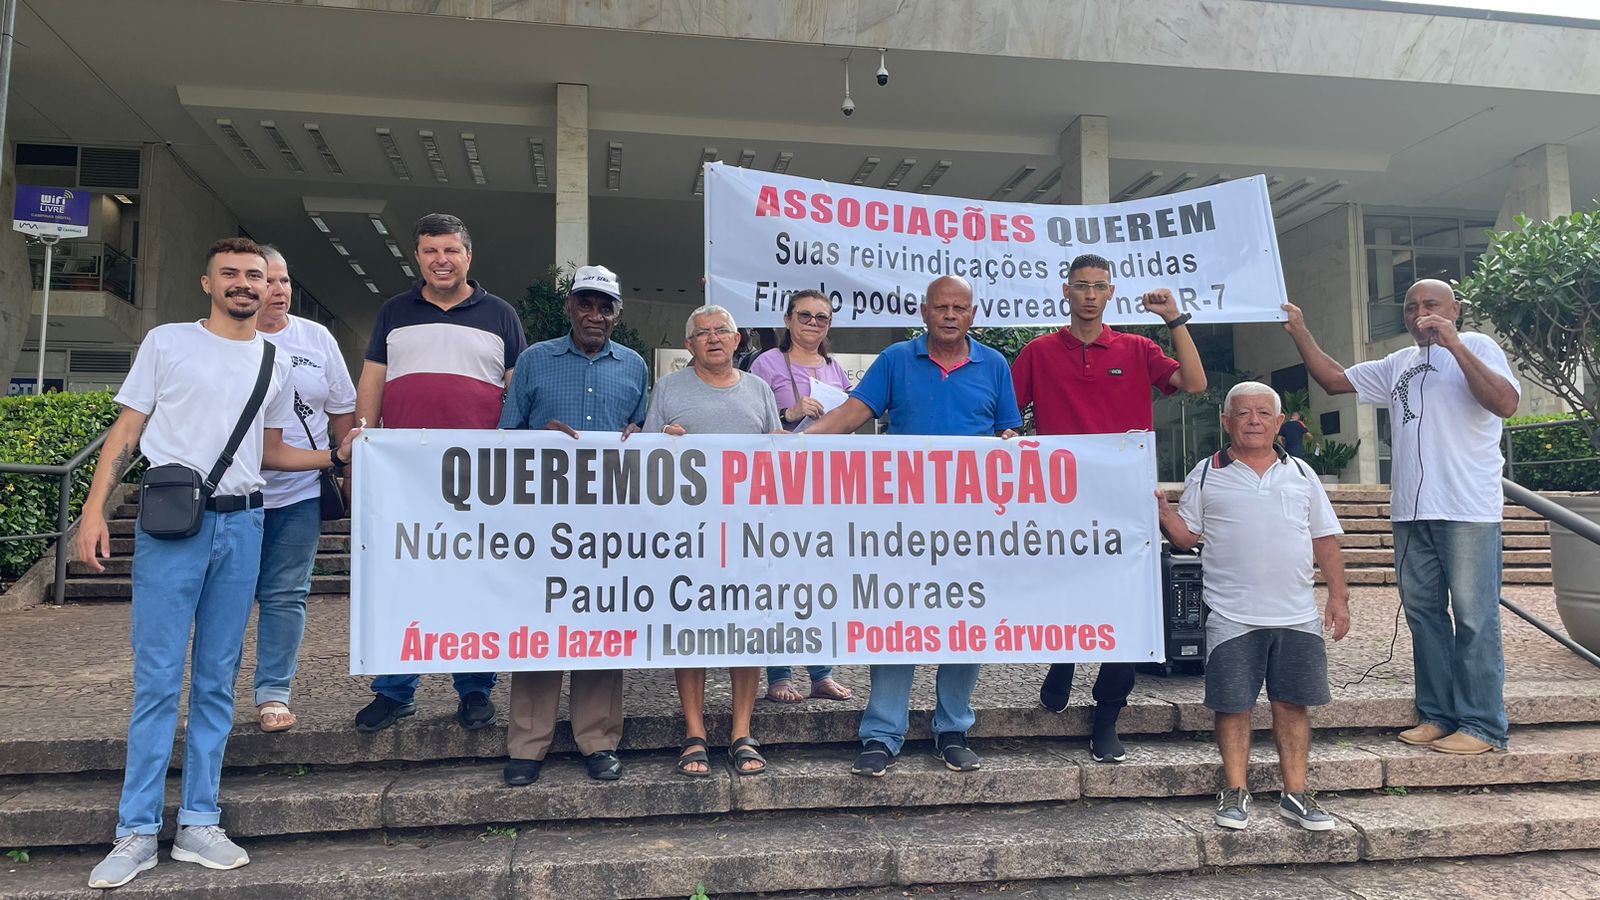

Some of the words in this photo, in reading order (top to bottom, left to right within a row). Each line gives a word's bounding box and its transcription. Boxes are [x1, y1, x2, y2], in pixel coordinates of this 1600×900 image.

[40, 205, 65, 213] LIVRE
[755, 185, 1036, 244] ASSOCIAÇÕES
[1047, 200, 1216, 247] QUEREM
[775, 231, 840, 265] Suas
[850, 243, 1049, 285] reivindicações
[1058, 250, 1198, 279] andidas
[852, 286, 926, 321] pode
[1178, 283, 1226, 312] R-7
[441, 446, 708, 512] QUEREMOS
[722, 440, 1078, 516] PAVIMENTAÇÃO
[394, 522, 536, 560] Núcleo
[550, 521, 706, 568] Sapucaí
[742, 522, 834, 558] Nova
[848, 520, 1123, 566] Independência
[545, 575, 655, 613] Paulo
[669, 574, 838, 620] Camargo
[852, 573, 986, 609] Moraes
[400, 620, 500, 661] Áreas
[508, 626, 549, 659] de
[557, 625, 637, 658] lazer
[662, 622, 823, 656] Lombadas
[847, 620, 942, 652] Podas
[949, 620, 987, 652] de
[994, 618, 1116, 651] árvores
